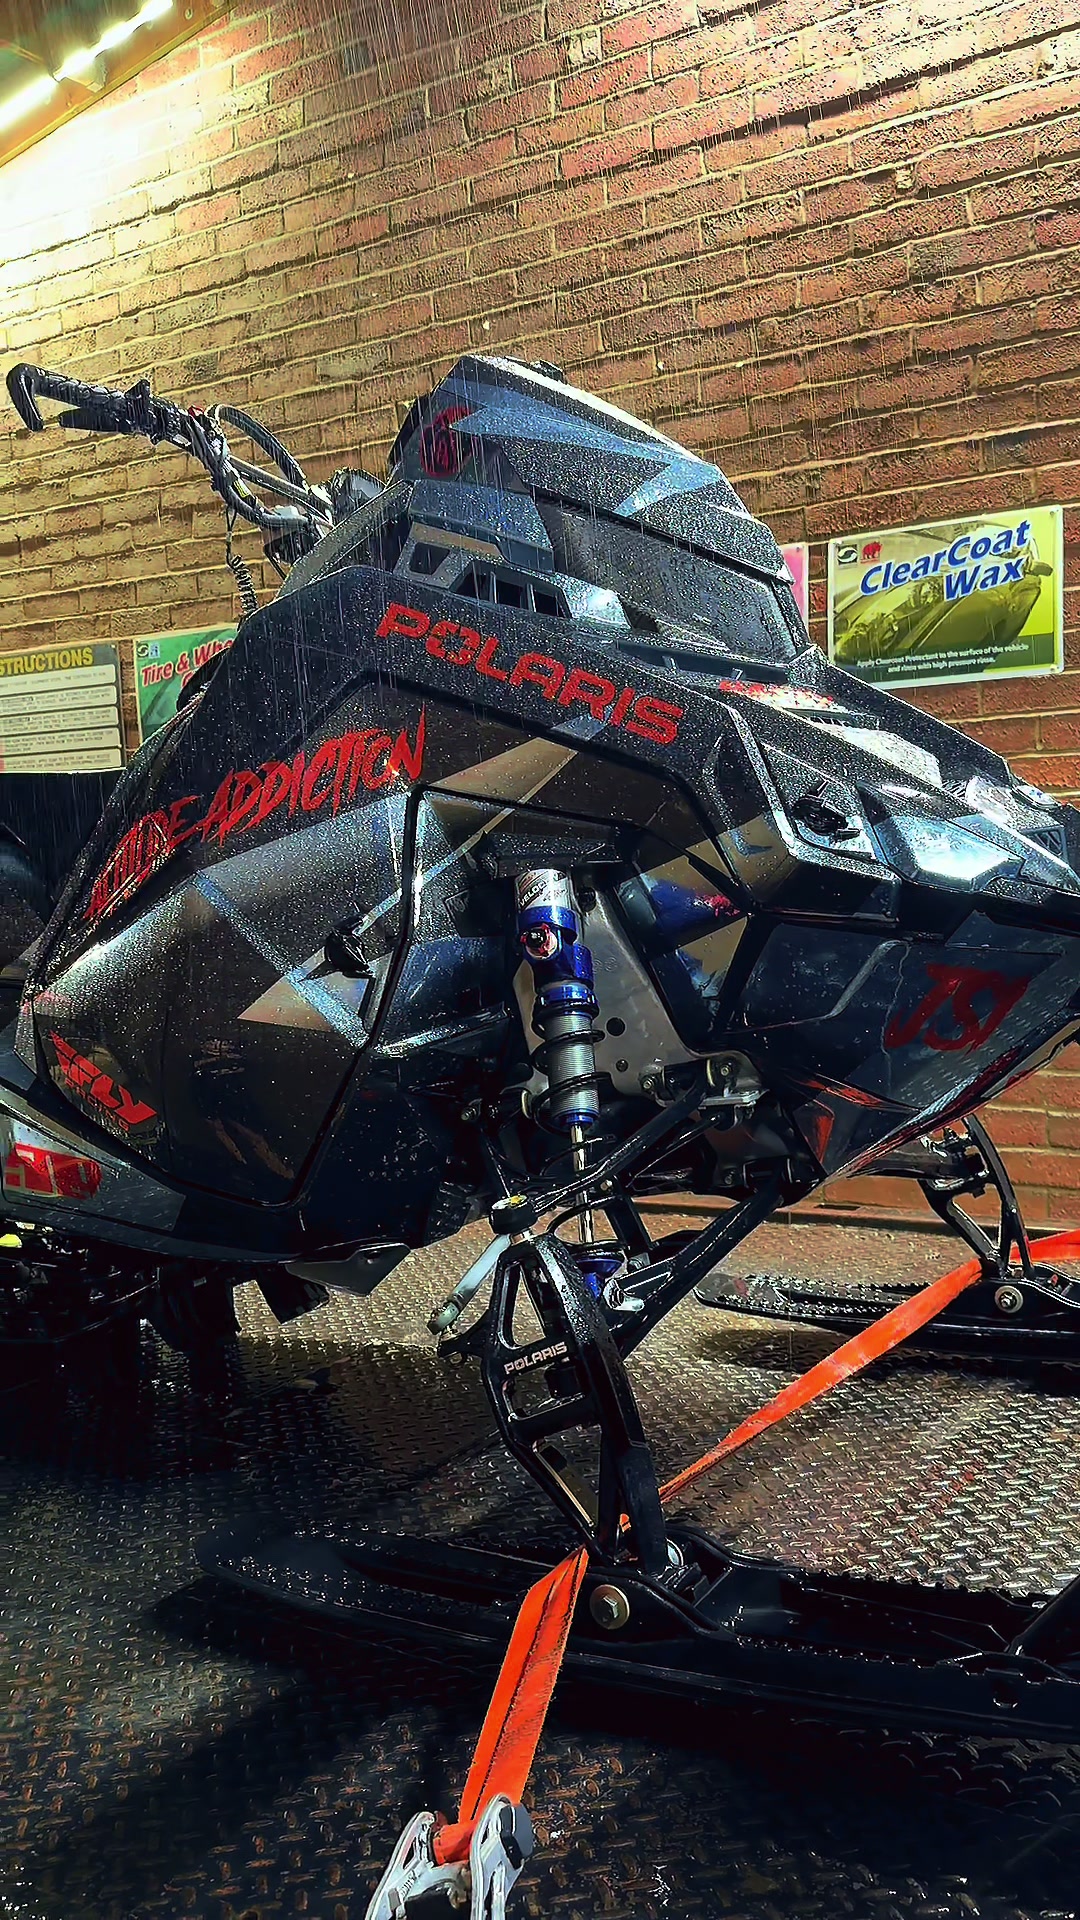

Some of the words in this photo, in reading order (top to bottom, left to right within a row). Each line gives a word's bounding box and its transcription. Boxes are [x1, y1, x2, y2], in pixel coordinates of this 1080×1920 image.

[860, 520, 1031, 596] ClearCoat
[943, 556, 1026, 600] Wax
[141, 661, 173, 687] Tire
[175, 651, 190, 674] &
[375, 602, 685, 745] POLARIS
[198, 700, 426, 848] ADDICTION
[503, 1341, 568, 1375] POLARIS
